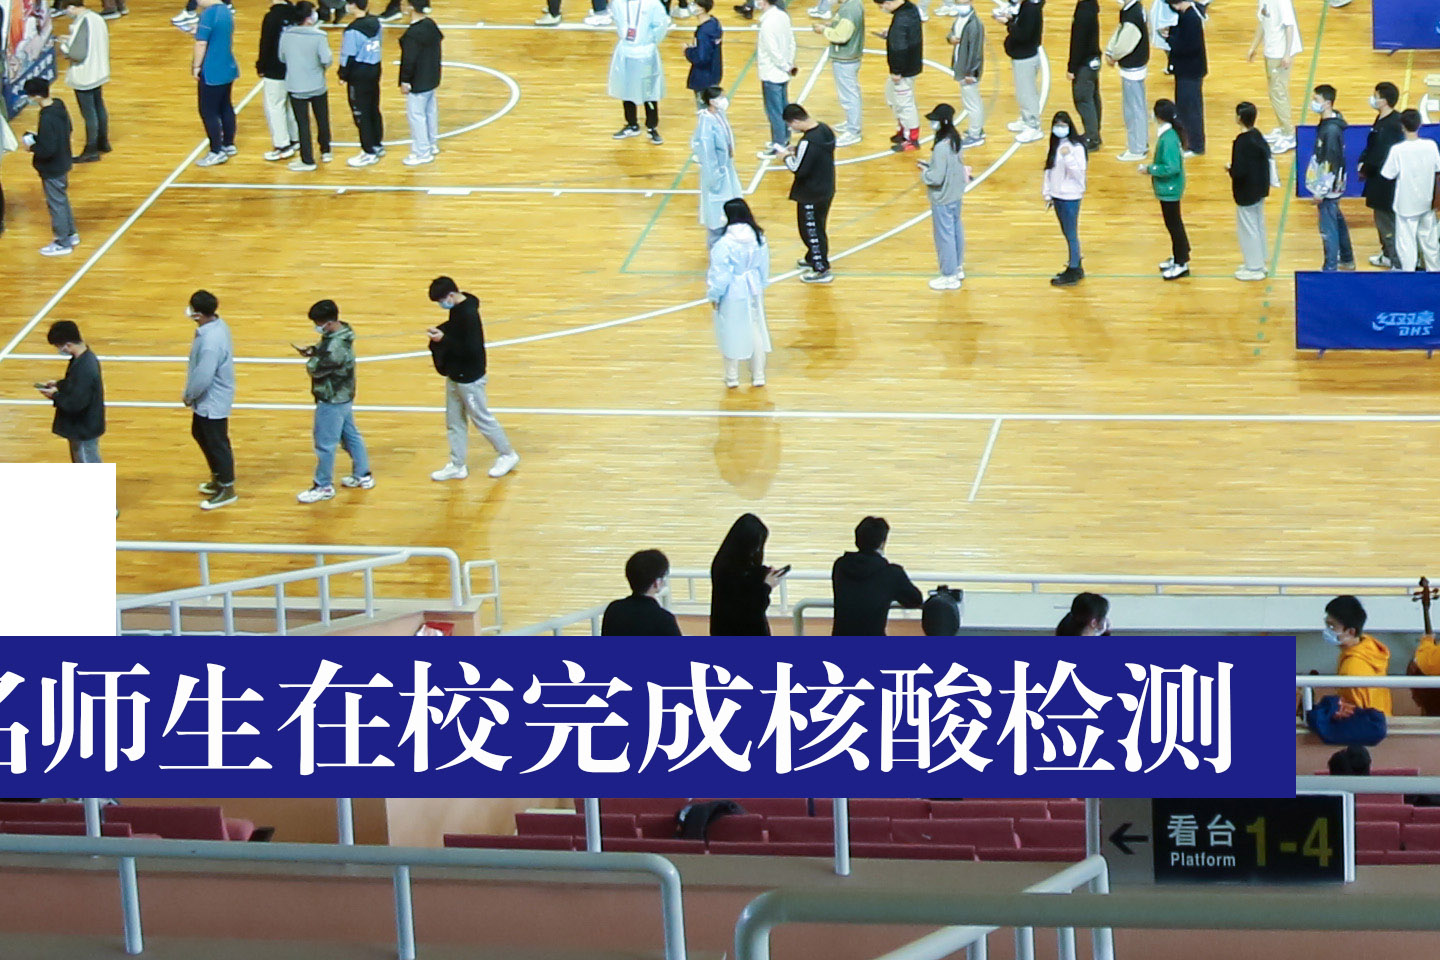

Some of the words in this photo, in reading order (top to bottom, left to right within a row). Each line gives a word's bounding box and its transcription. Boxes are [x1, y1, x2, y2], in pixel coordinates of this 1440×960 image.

[1167, 814, 1236, 847] 看台
[1246, 816, 1333, 867] 1-4
[1170, 851, 1236, 867] Platform
